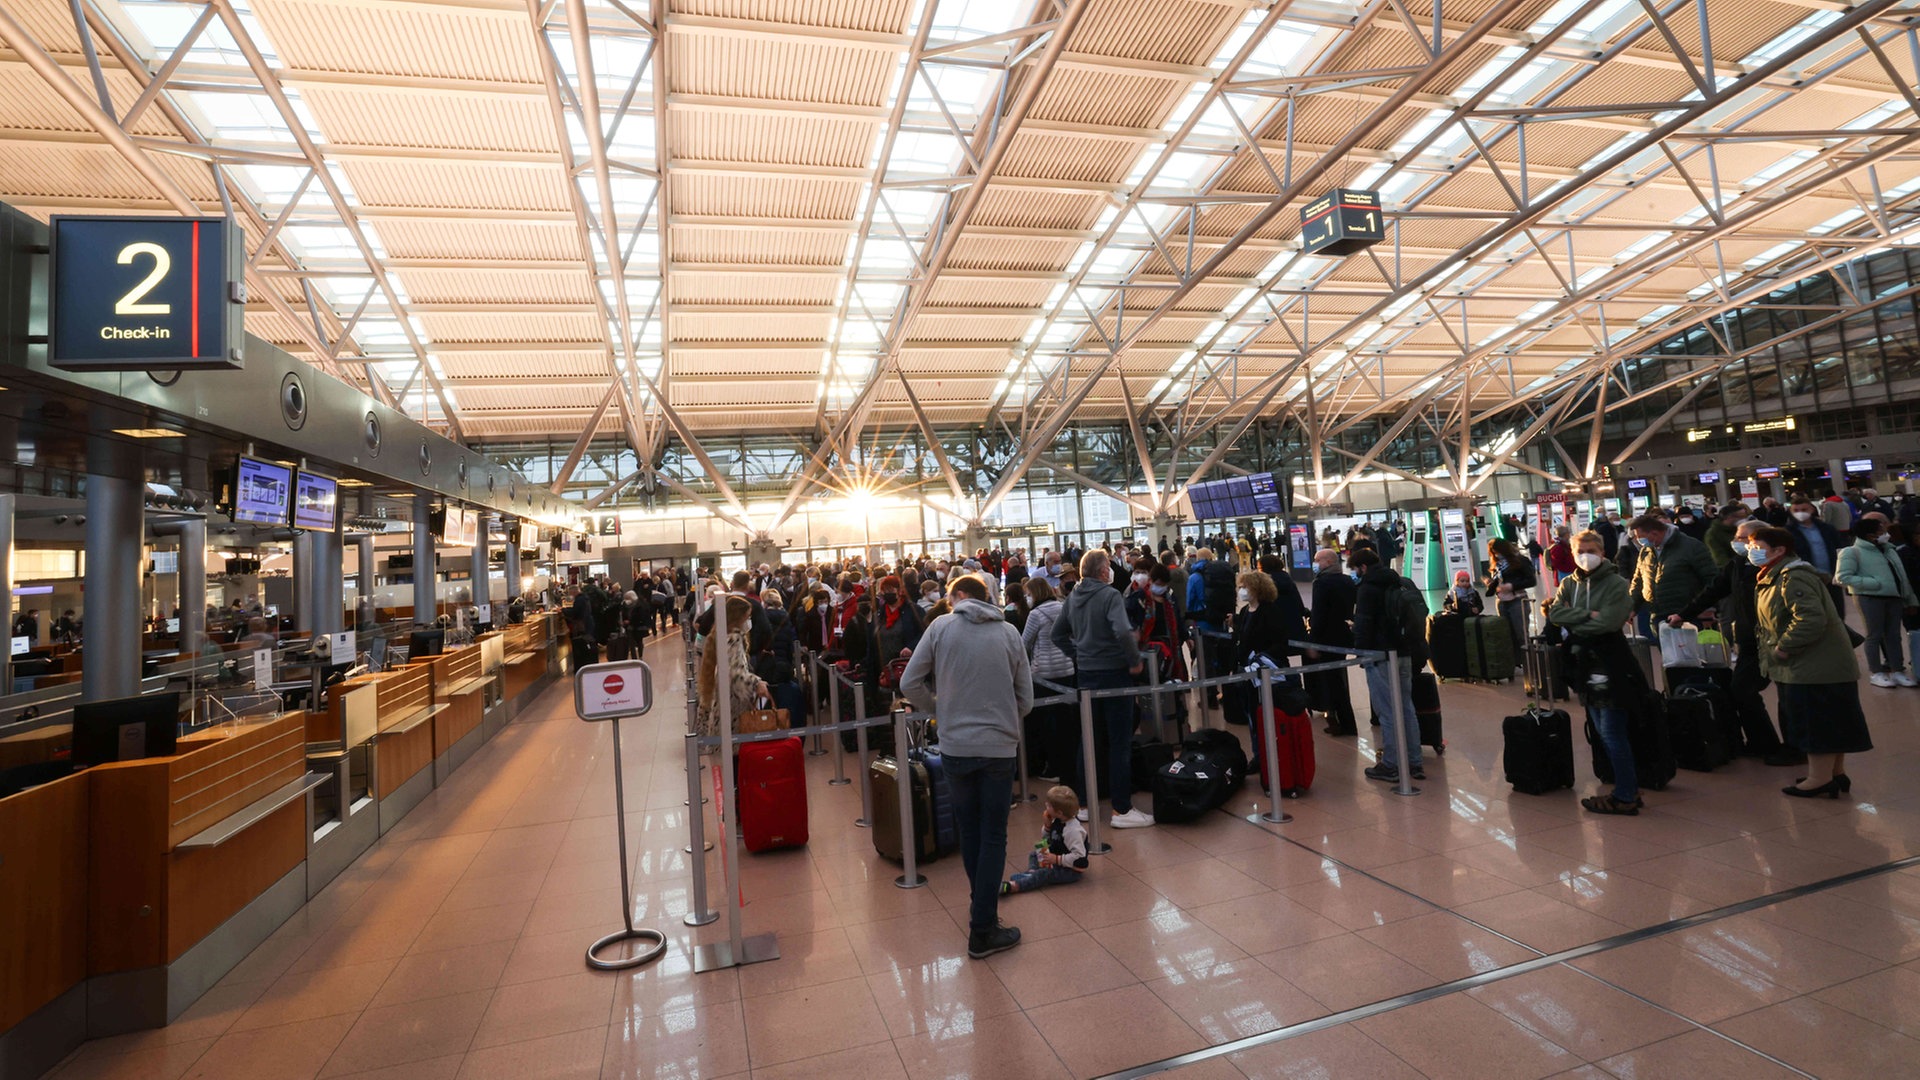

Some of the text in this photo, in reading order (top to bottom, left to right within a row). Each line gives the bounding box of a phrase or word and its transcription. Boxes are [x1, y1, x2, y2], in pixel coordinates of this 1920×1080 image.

[1325, 216, 1333, 236] 1
[1366, 212, 1375, 232] 1
[115, 242, 171, 314] 2
[100, 326, 170, 340] Check-in
[606, 518, 615, 529] 2
